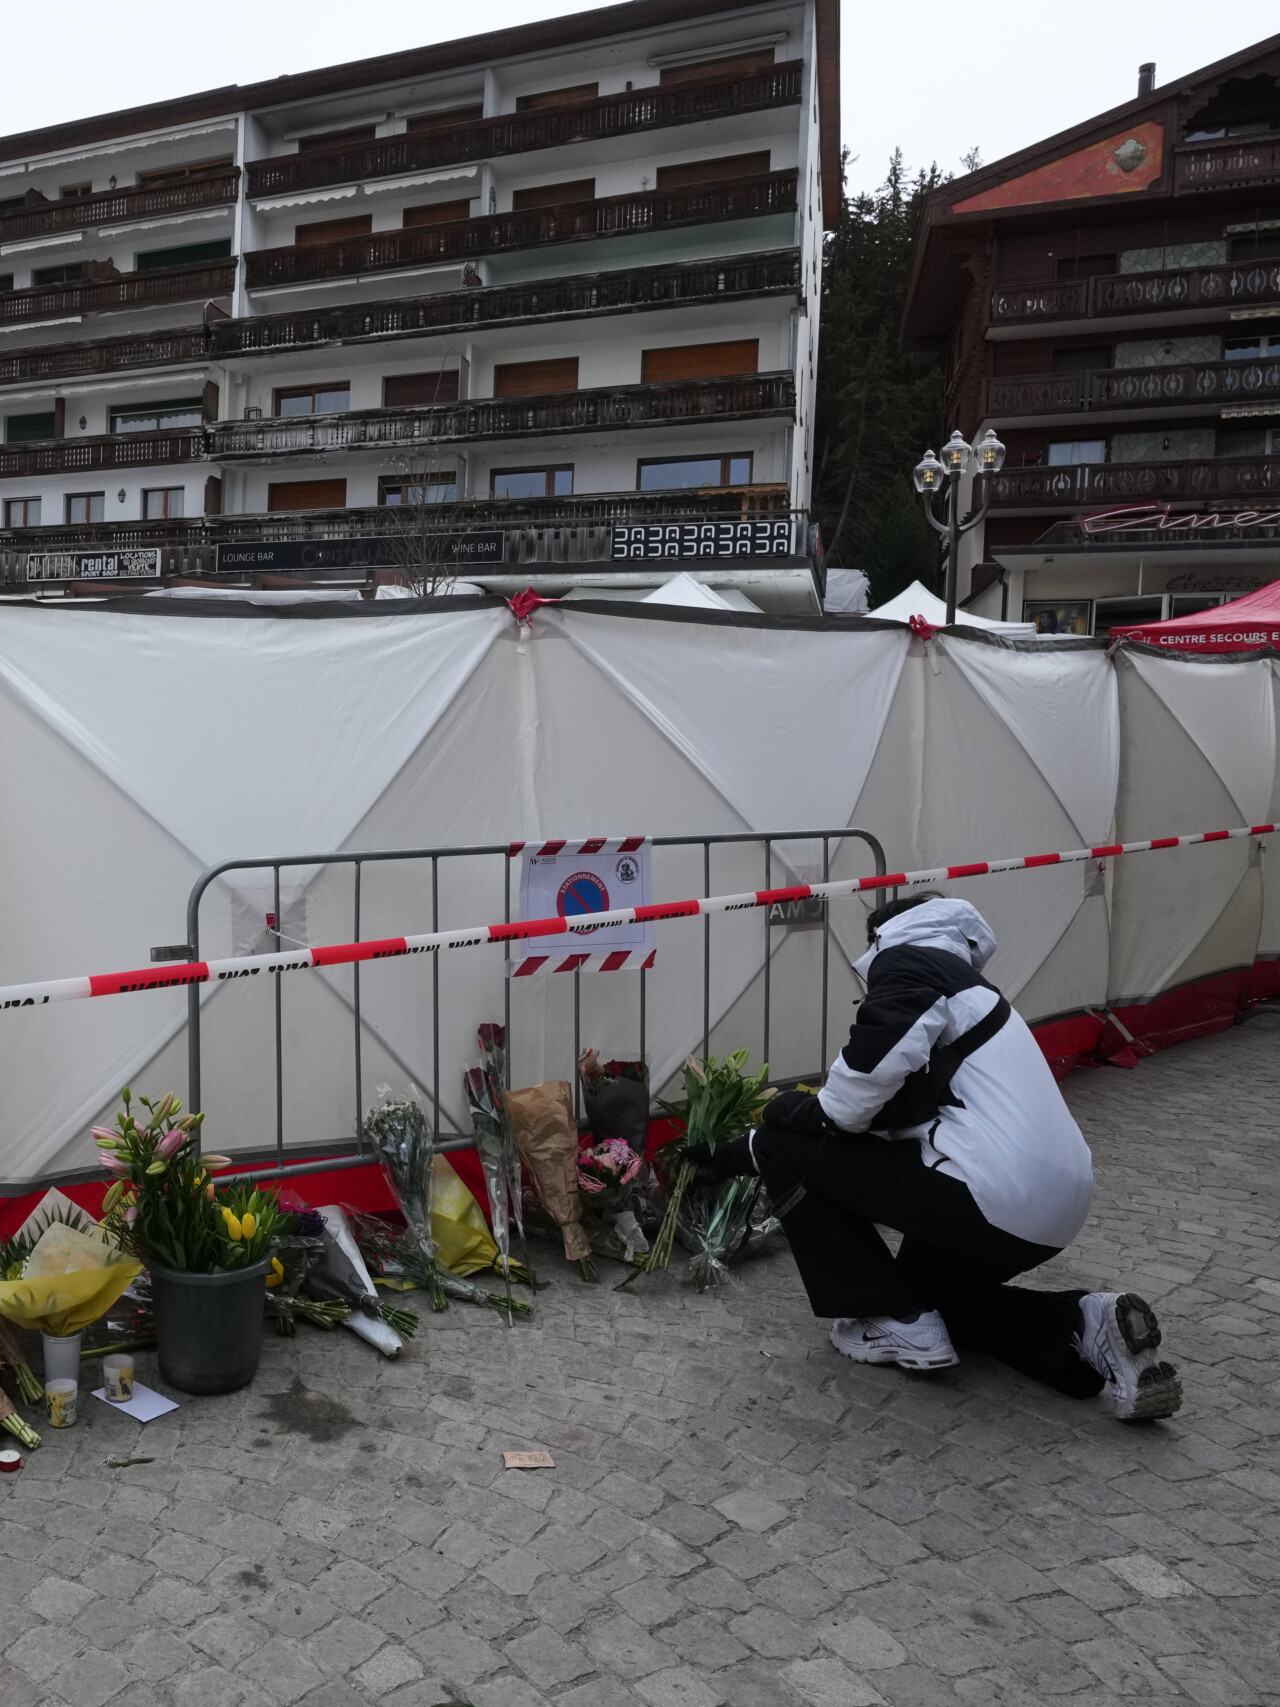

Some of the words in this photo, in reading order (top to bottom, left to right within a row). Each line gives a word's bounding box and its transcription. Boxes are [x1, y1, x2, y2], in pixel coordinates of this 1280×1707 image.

[1080, 500, 1280, 533] Cine
[451, 544, 476, 554] WINE
[478, 542, 496, 552] BAR
[120, 551, 156, 560] LOCATIONS
[223, 552, 256, 563] LOUNGE
[257, 551, 274, 561] BAR
[81, 555, 118, 571] rental
[1160, 634, 1207, 645] CENTRE
[1210, 632, 1267, 643] SECOURS
[560, 872, 605, 894] STATIONNEMENT
